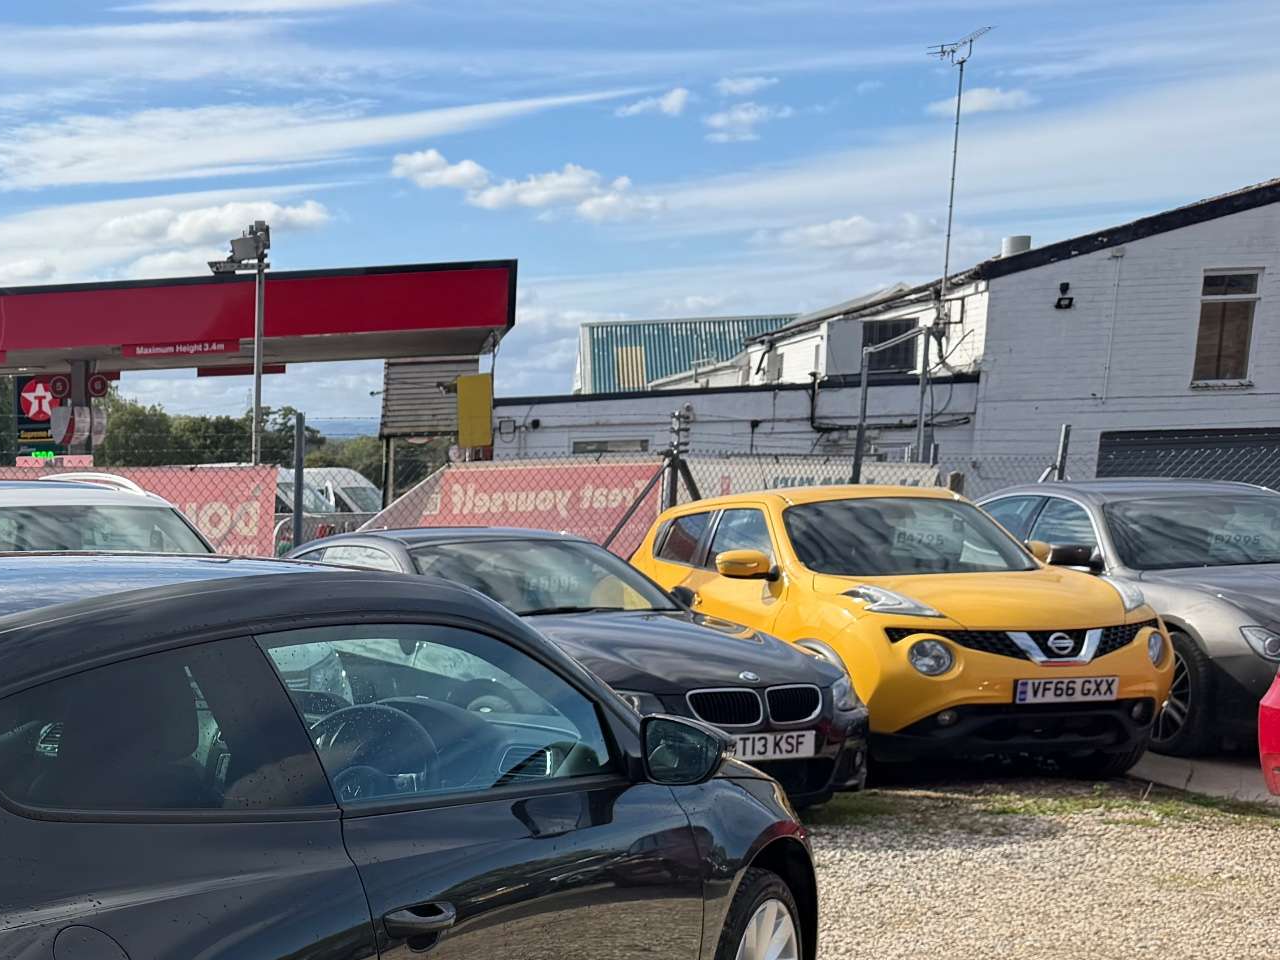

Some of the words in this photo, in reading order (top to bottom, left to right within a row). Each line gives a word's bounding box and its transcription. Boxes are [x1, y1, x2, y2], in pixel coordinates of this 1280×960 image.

[135, 345, 174, 355] Maximum
[175, 343, 202, 354] Height
[203, 342, 225, 352] 3.4m
[1031, 680, 1077, 699] VF66
[1081, 678, 1117, 697] GXX
[733, 735, 768, 757] T13
[772, 733, 806, 755] KSF
